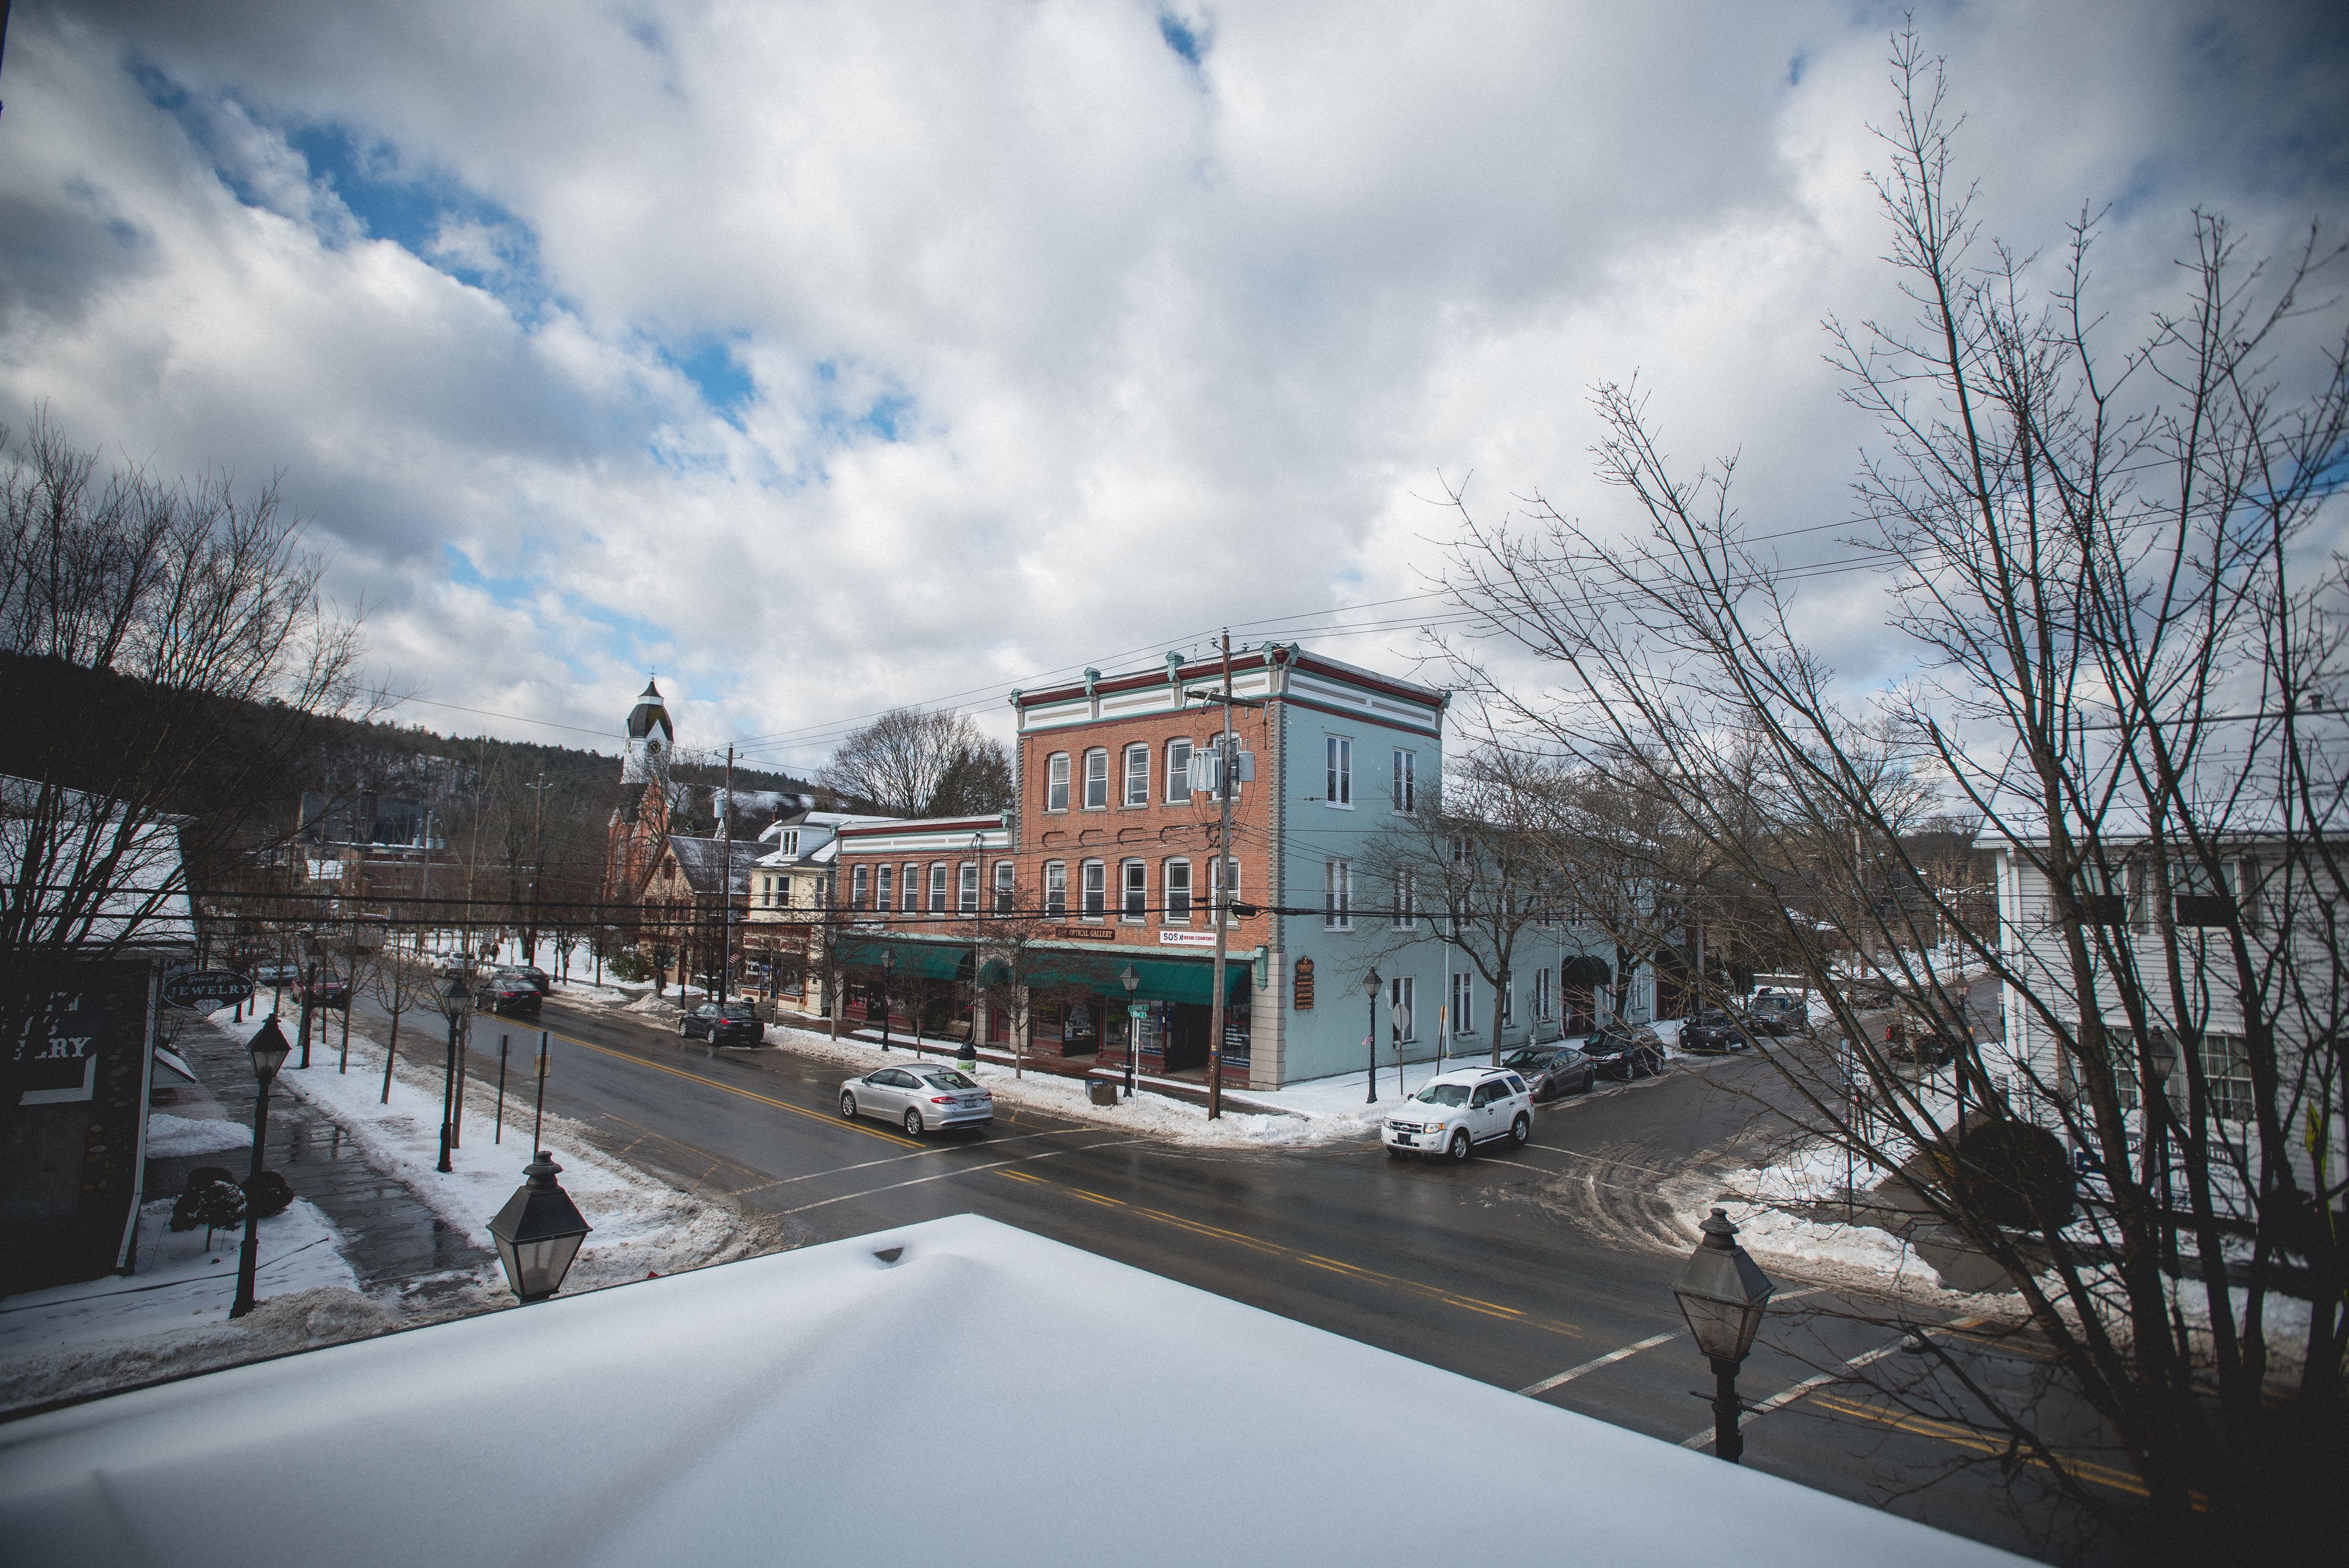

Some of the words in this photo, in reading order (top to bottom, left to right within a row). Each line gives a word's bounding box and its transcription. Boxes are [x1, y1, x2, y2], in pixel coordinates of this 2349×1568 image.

[1163, 932, 1178, 941] SOS
[187, 975, 214, 984] Golden
[167, 984, 251, 999] JEWELRY
